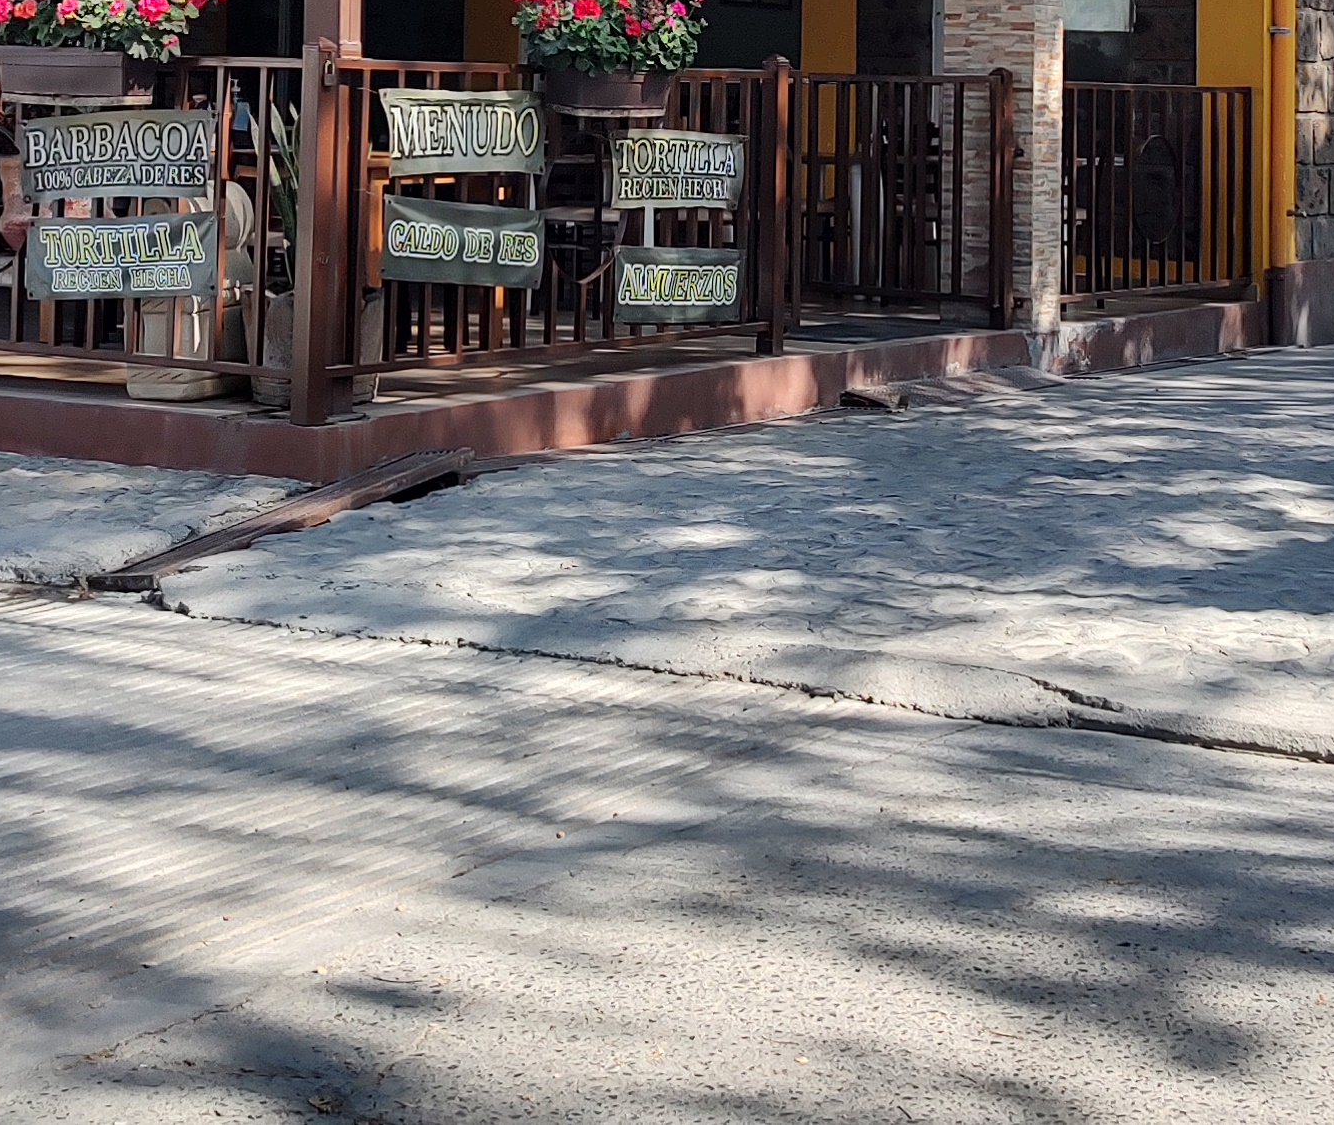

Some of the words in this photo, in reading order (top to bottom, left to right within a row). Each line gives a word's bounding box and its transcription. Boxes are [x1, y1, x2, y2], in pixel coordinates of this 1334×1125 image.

[25, 121, 209, 168] BARBACOA
[390, 103, 539, 159] MENUDO
[35, 169, 71, 191] 100%
[74, 165, 137, 188] CABEZA
[141, 164, 165, 185] DE
[168, 165, 206, 186] RES
[616, 138, 736, 176] TORTILLA
[619, 177, 678, 200] RECIEN
[40, 221, 205, 267] TORTILLA
[388, 220, 459, 261] CALDO
[463, 228, 494, 263] DE
[497, 232, 539, 266] RES
[52, 268, 122, 292] RECIEN
[129, 266, 192, 290] HECHA
[618, 263, 738, 306] ALMUERZOS
